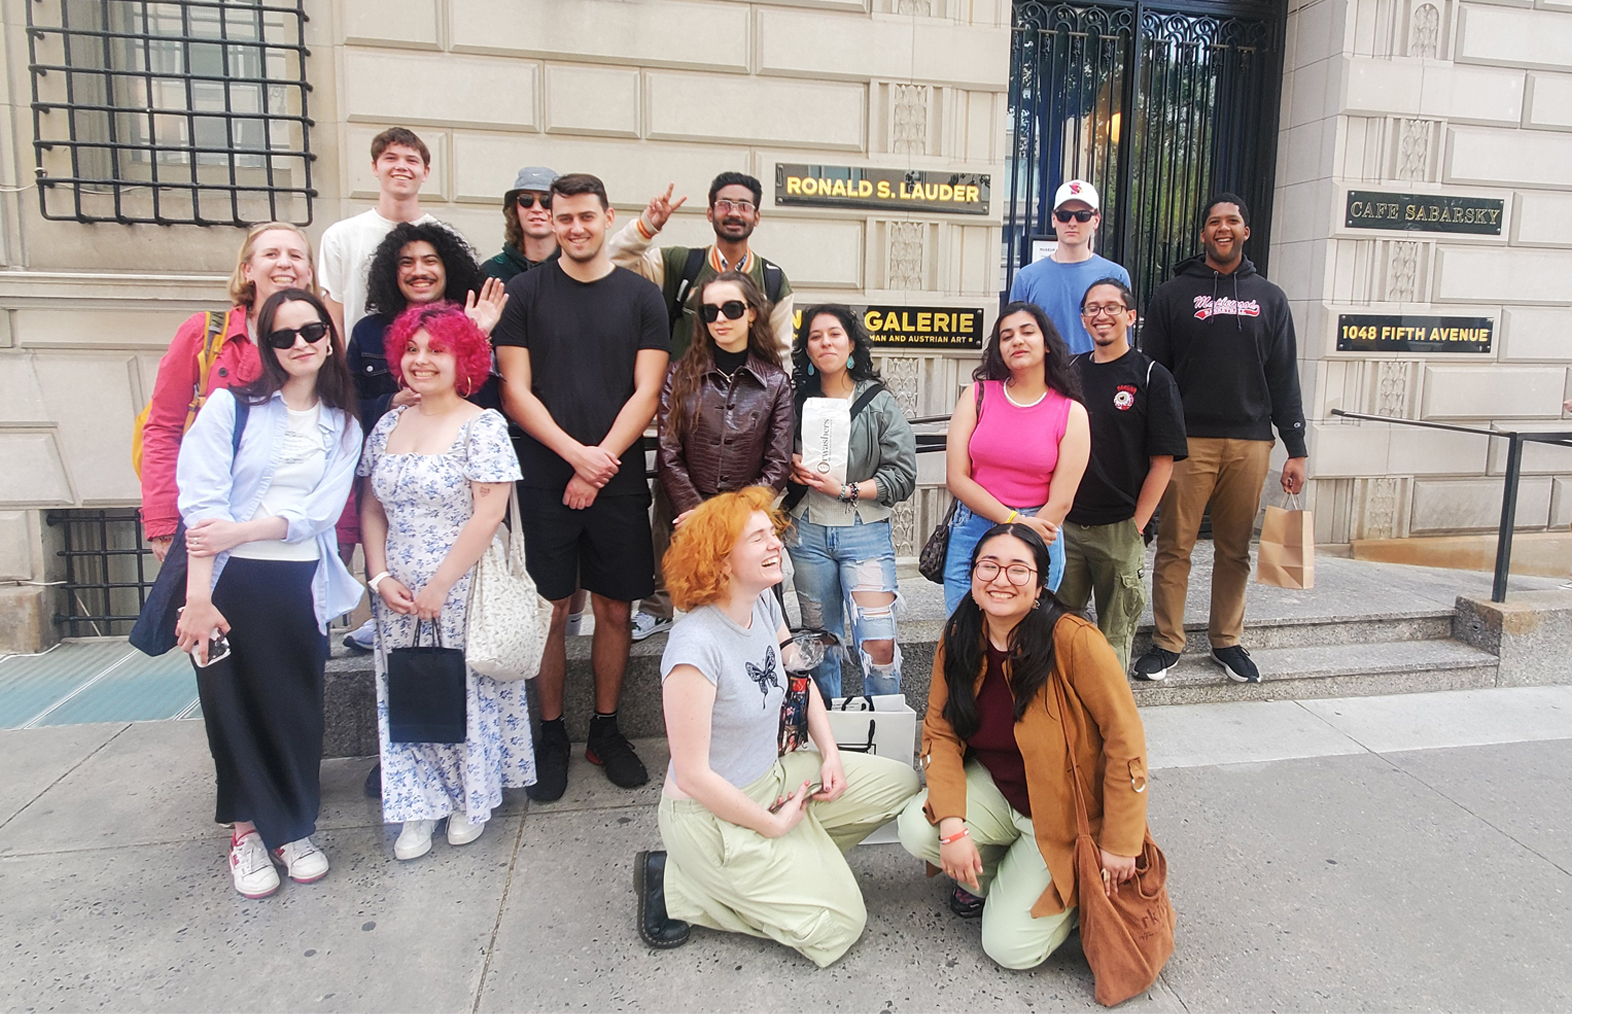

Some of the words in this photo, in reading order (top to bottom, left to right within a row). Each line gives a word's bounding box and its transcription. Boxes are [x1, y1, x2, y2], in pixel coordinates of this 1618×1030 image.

[786, 176, 874, 197] RONALD
[876, 180, 896, 199] S.
[900, 182, 980, 203] LAUDER
[1350, 202, 1399, 220] CAFE
[1405, 204, 1500, 225] SABARSKY
[864, 311, 974, 333] GALERIE
[908, 335, 949, 343] AUSTRIAN
[951, 336, 966, 344] ART
[1342, 325, 1377, 340] 1048
[1381, 327, 1426, 341] FIFTH
[1430, 327, 1488, 342] AVENUE
